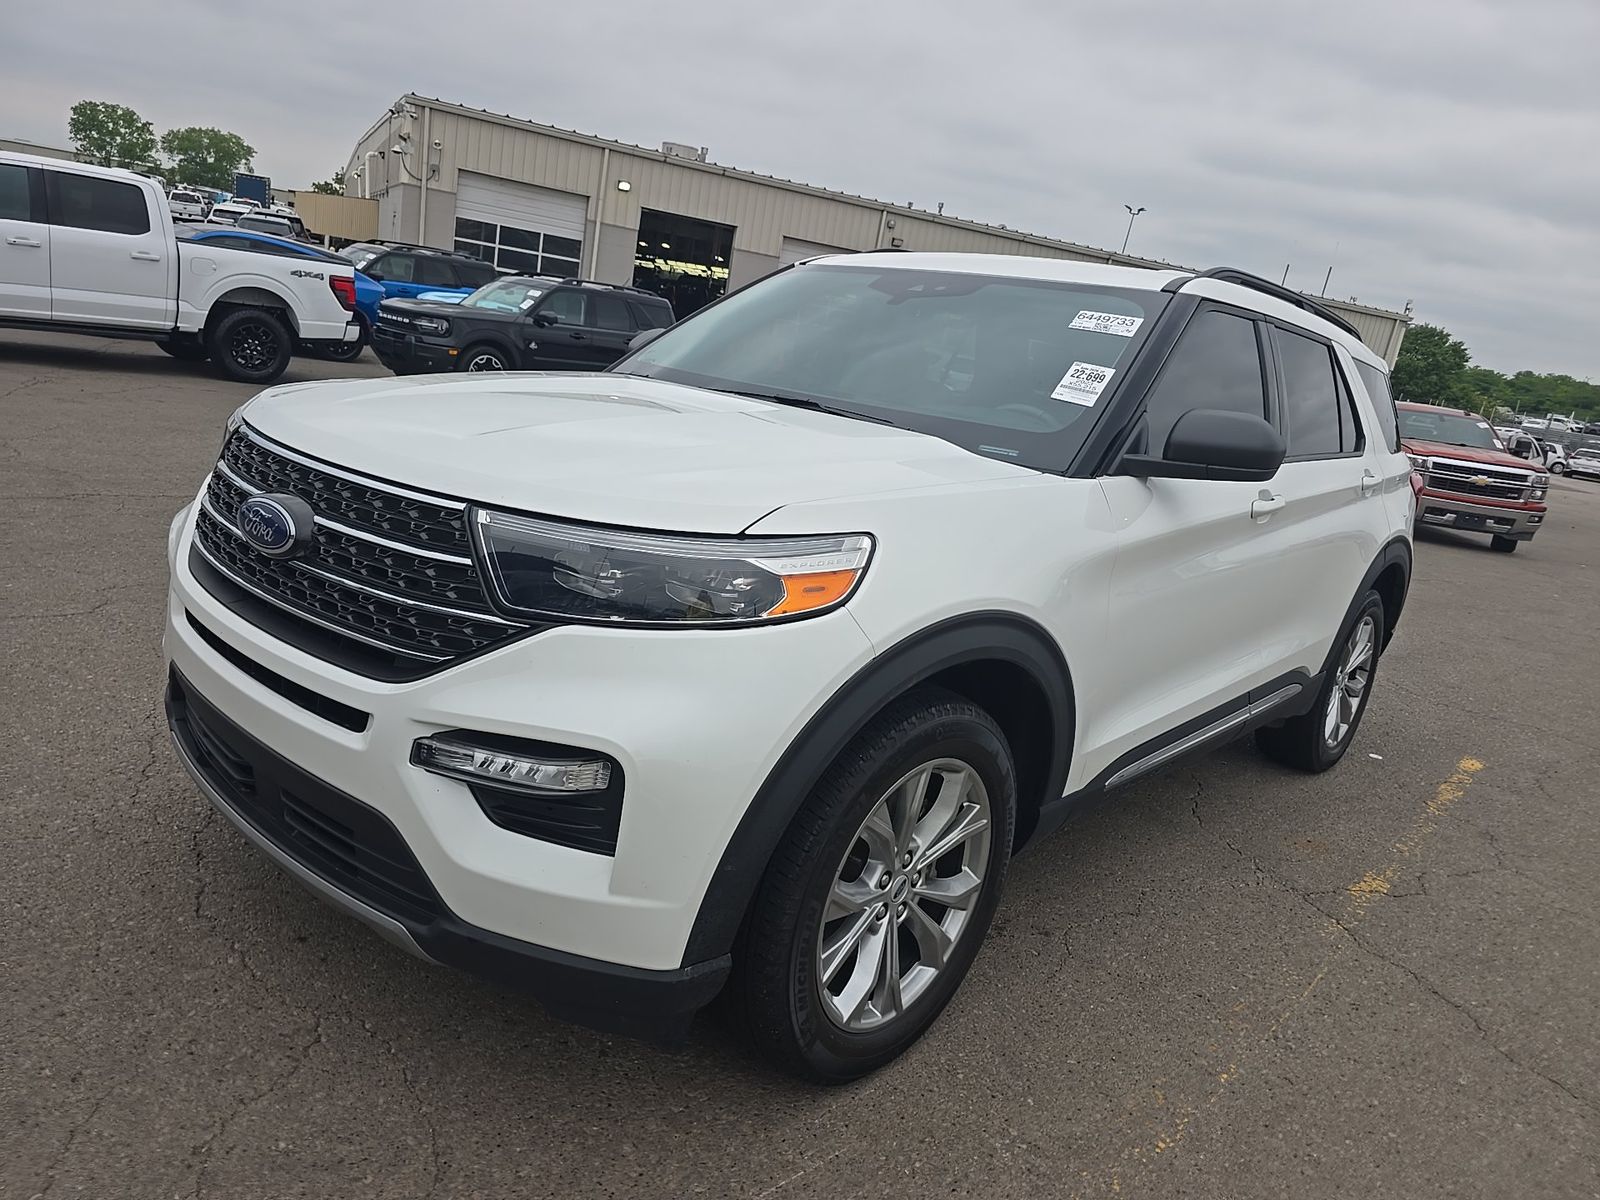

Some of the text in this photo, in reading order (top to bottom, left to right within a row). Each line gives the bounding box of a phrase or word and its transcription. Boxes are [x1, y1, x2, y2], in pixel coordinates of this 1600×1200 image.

[1077, 312, 1135, 327] 6449733
[1070, 368, 1106, 383] 22:699
[243, 506, 278, 541] Ford
[779, 558, 853, 569] EXPLORER
